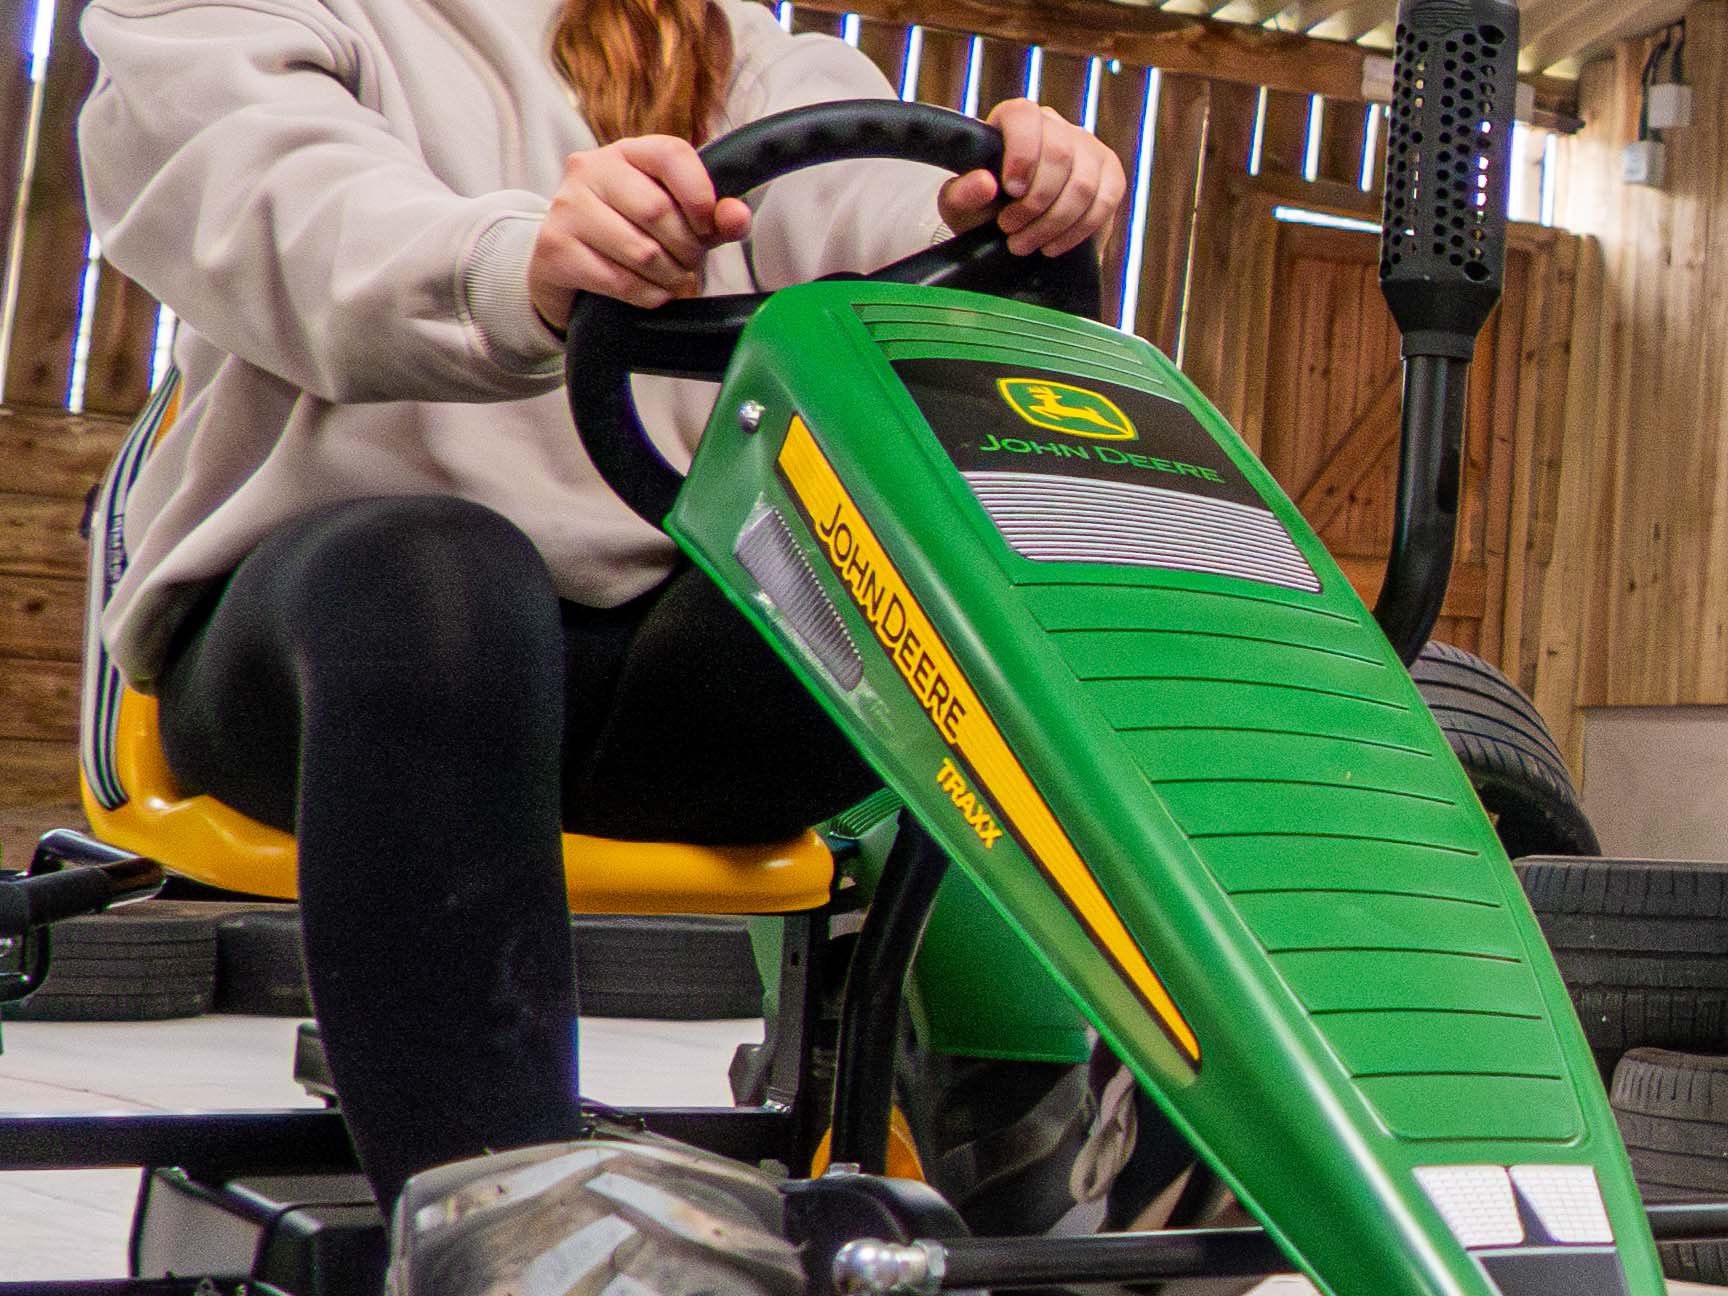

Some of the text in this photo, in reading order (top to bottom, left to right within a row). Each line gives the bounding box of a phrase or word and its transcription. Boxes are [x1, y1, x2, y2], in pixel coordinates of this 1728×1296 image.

[979, 434, 1226, 484] JOHN DEERE
[821, 503, 967, 740] JOHN DEERE
[936, 758, 1004, 850] TRAXX
